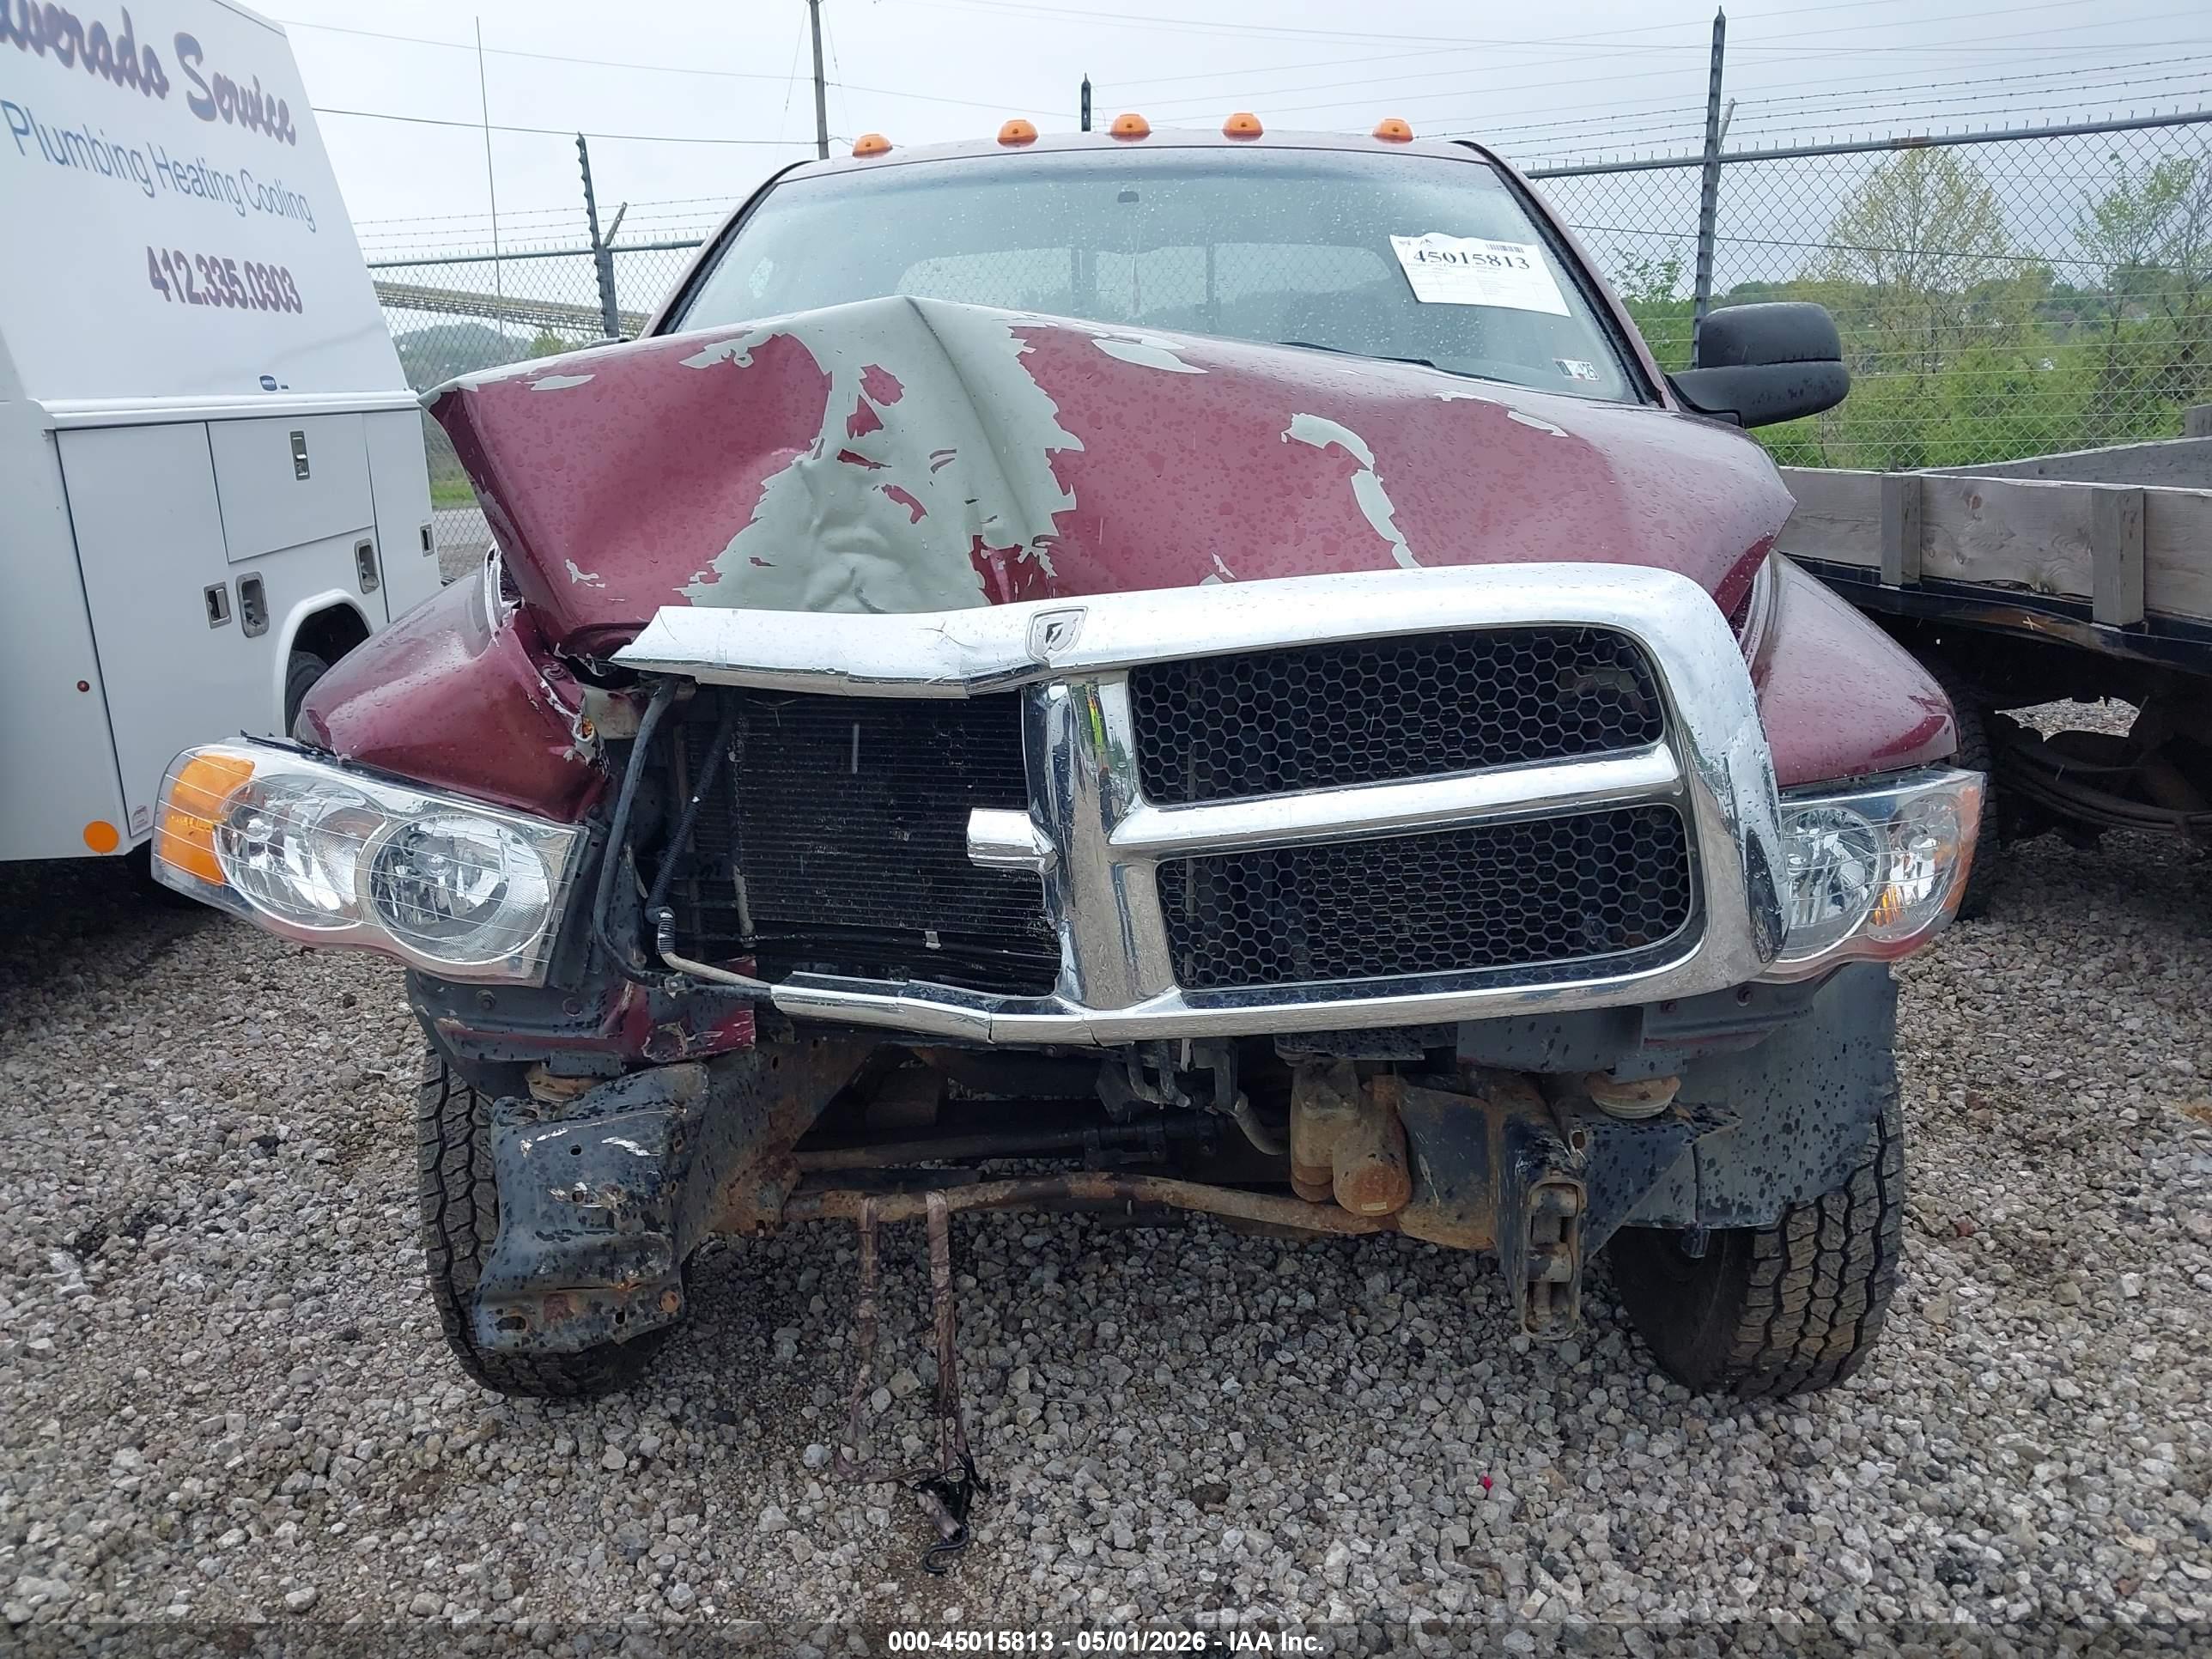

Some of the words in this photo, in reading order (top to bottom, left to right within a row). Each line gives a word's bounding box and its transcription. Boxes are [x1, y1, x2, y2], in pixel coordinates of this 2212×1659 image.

[173, 32, 296, 146] Service
[0, 100, 155, 198] Plumbing
[146, 142, 246, 217] Heating
[240, 168, 316, 234] Cooling
[146, 246, 303, 314] 412.335.0303
[1413, 249, 1530, 270] 45015813
